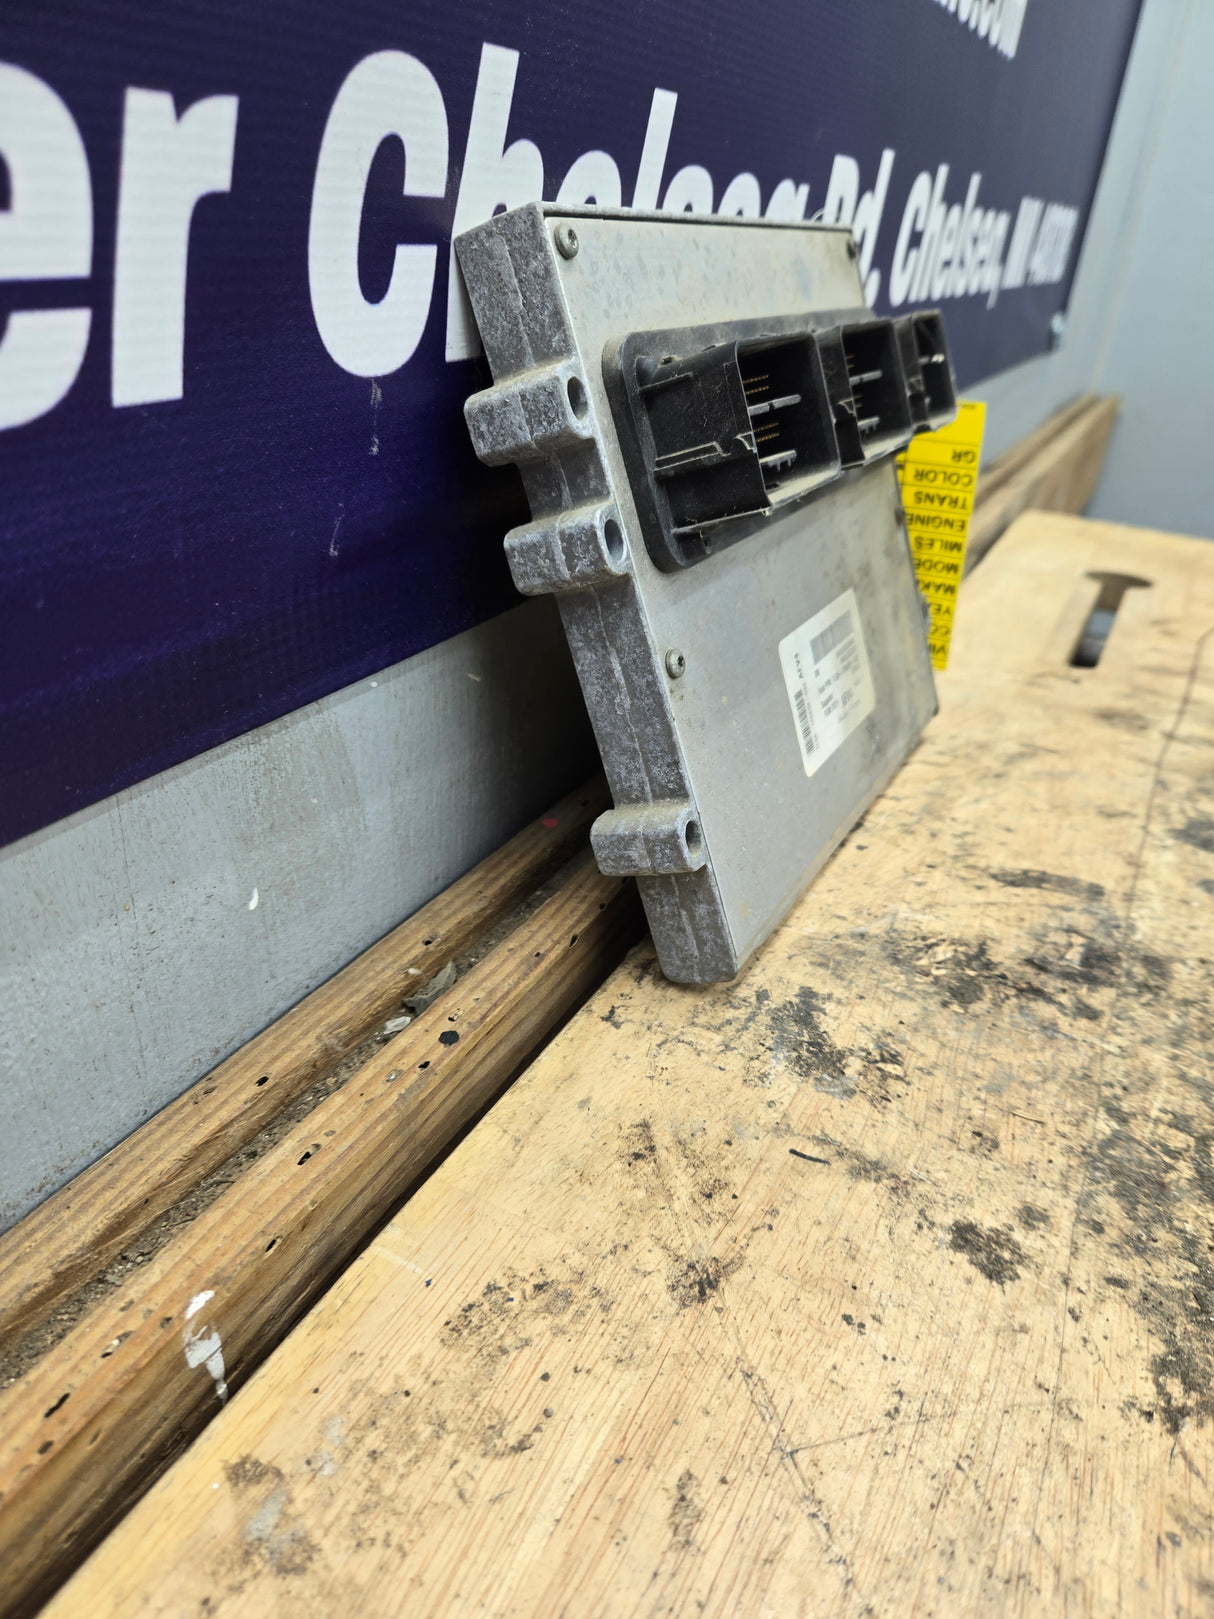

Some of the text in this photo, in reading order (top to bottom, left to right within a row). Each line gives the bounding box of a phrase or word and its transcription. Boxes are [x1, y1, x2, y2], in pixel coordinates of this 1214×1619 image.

[951, 450, 975, 463] GR
[914, 468, 973, 487] COLOR
[914, 491, 968, 510] TRANS
[907, 513, 966, 531] ENGINE
[914, 536, 962, 552] MILES
[914, 559, 959, 574] MODE
[919, 579, 956, 595] MAK
